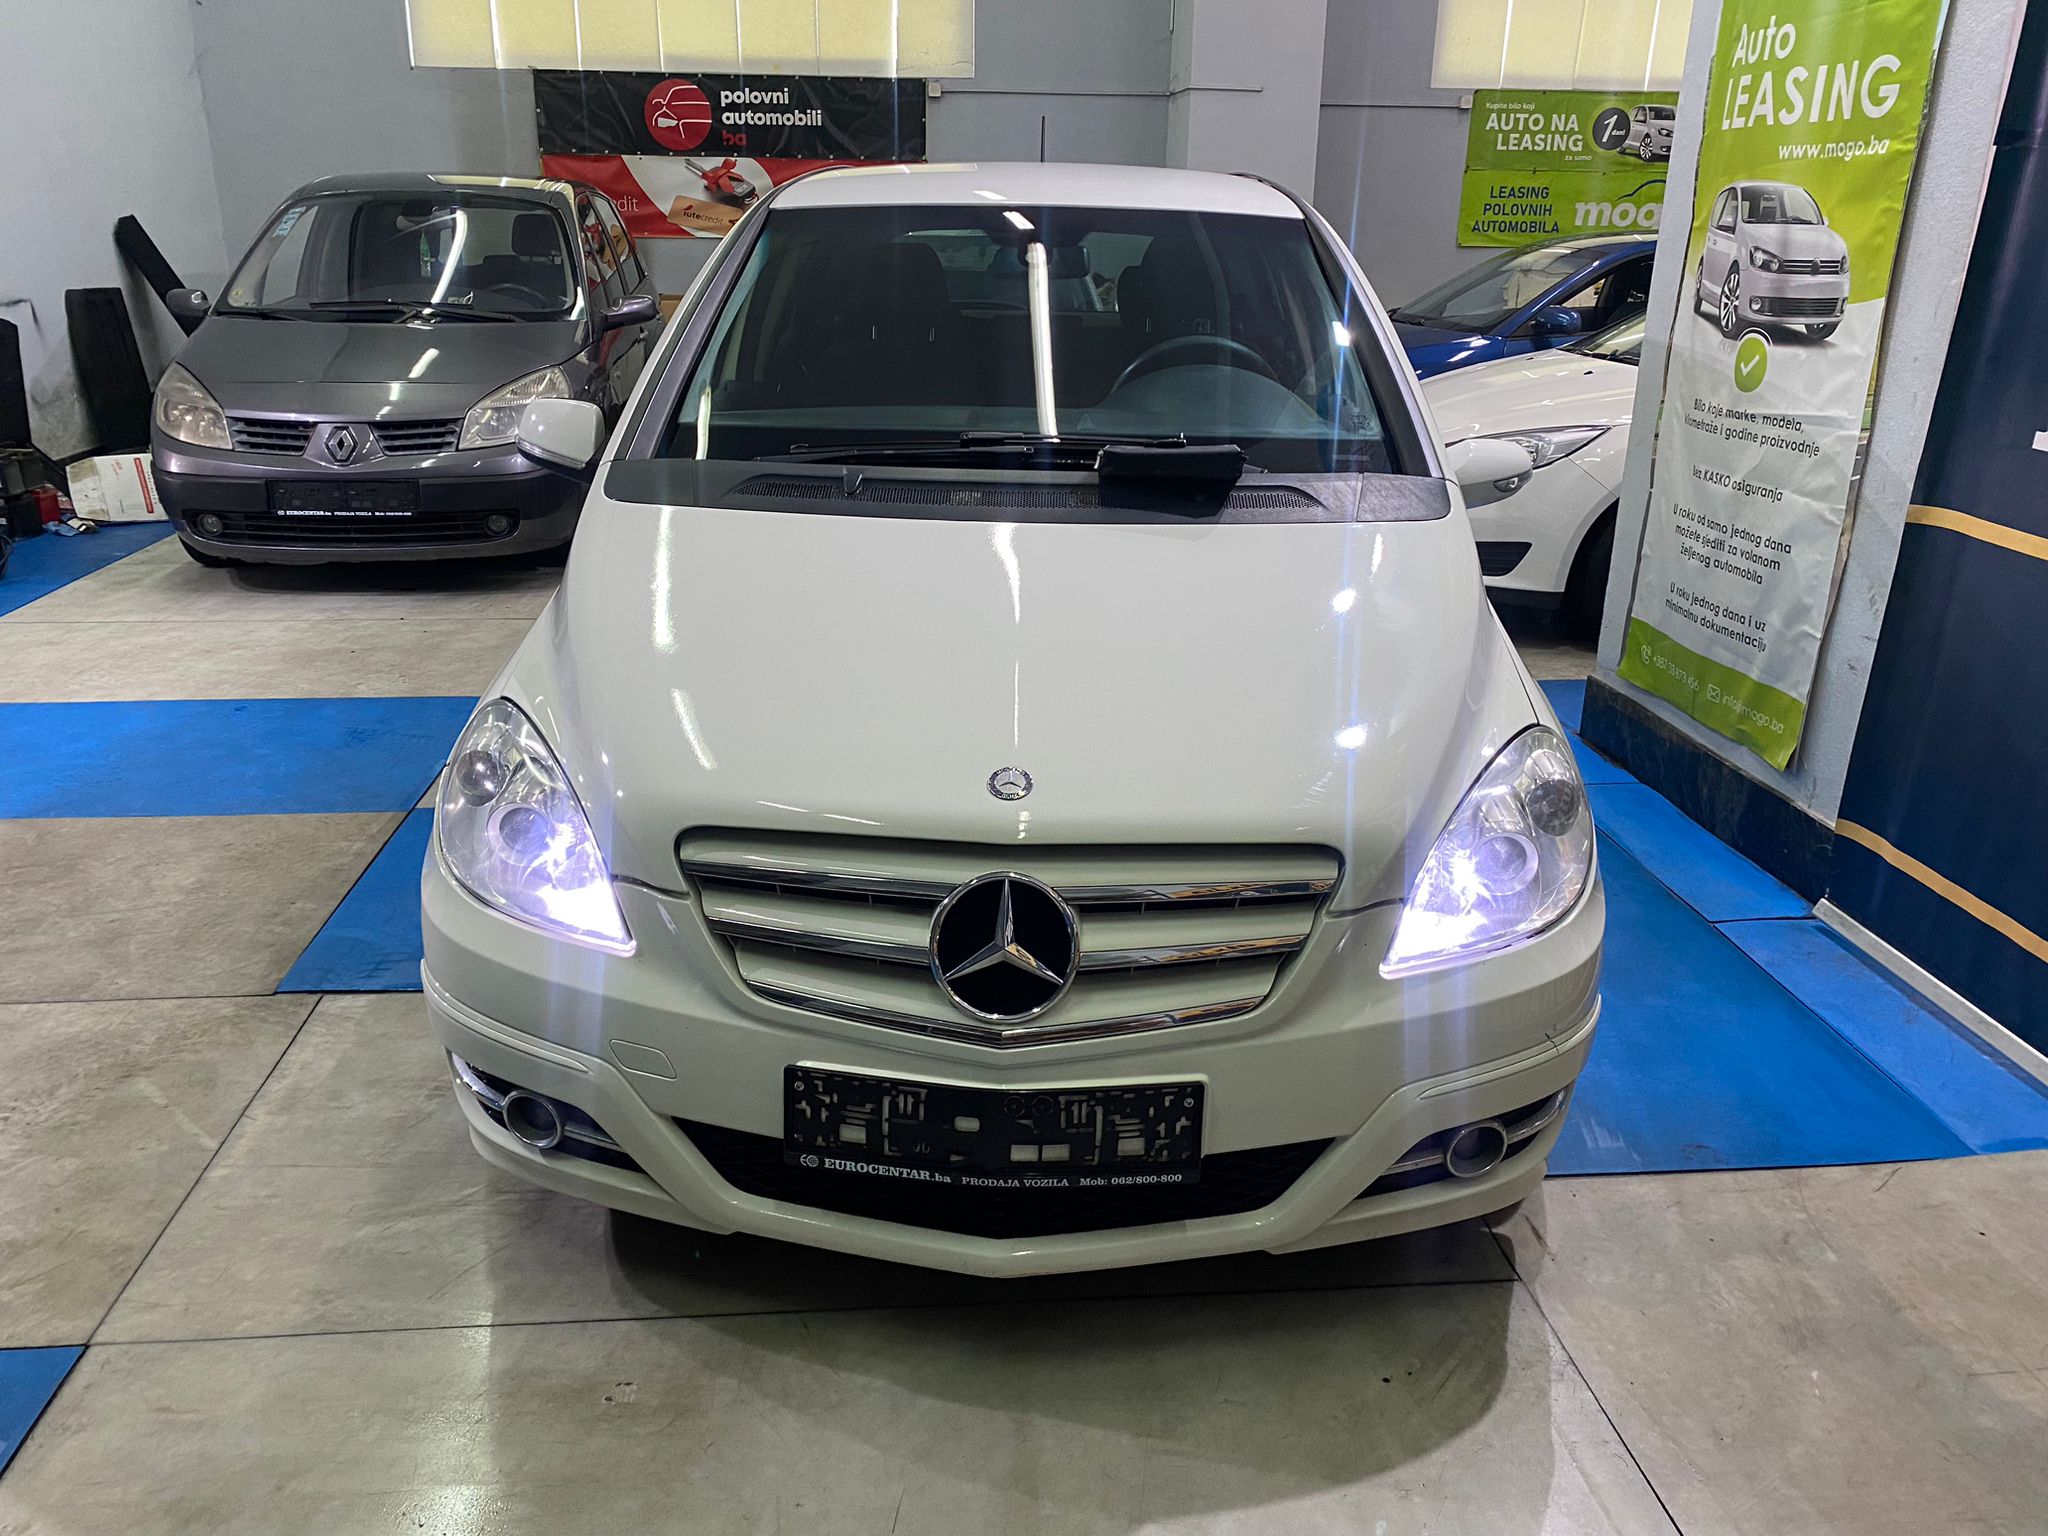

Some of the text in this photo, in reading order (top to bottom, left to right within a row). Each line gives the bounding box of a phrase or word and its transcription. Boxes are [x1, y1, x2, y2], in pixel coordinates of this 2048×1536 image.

[1731, 15, 1796, 68] Auto
[720, 87, 790, 105] polovni
[1508, 102, 1522, 110] bilo
[1721, 54, 1902, 130] LEASING
[721, 109, 823, 127] automobili
[1485, 113, 1580, 132] AUTO NA
[1601, 114, 1618, 143] 1
[1496, 133, 1584, 152] LEASING
[1778, 135, 1891, 162] www.mogo.ba
[1489, 186, 1550, 199] LEASING
[1482, 203, 1553, 217] POLOVNIH
[1471, 220, 1560, 234] AUTOMOBILA
[1706, 401, 1723, 419] koje
[1725, 408, 1759, 425] marke,
[1762, 415, 1804, 434] modela,
[1719, 423, 1724, 436] i
[1725, 427, 1759, 443] godine
[1760, 434, 1820, 459] proizvodnje
[1702, 468, 1731, 488] KASKO
[1731, 478, 1783, 503] osiguranja
[1673, 502, 1792, 554] U roku od samo jednog dana
[1674, 524, 1781, 571] možete sjediti za volanom
[1680, 542, 1763, 585] željenog automobila
[1669, 581, 1767, 632] U roku jednog dana i uz
[1665, 598, 1767, 652] minimalnu dokumentaciju
[824, 1157, 1182, 1188] EUROCENTAR.ba PRODAJA VOZILA Mob: 062/800-800
